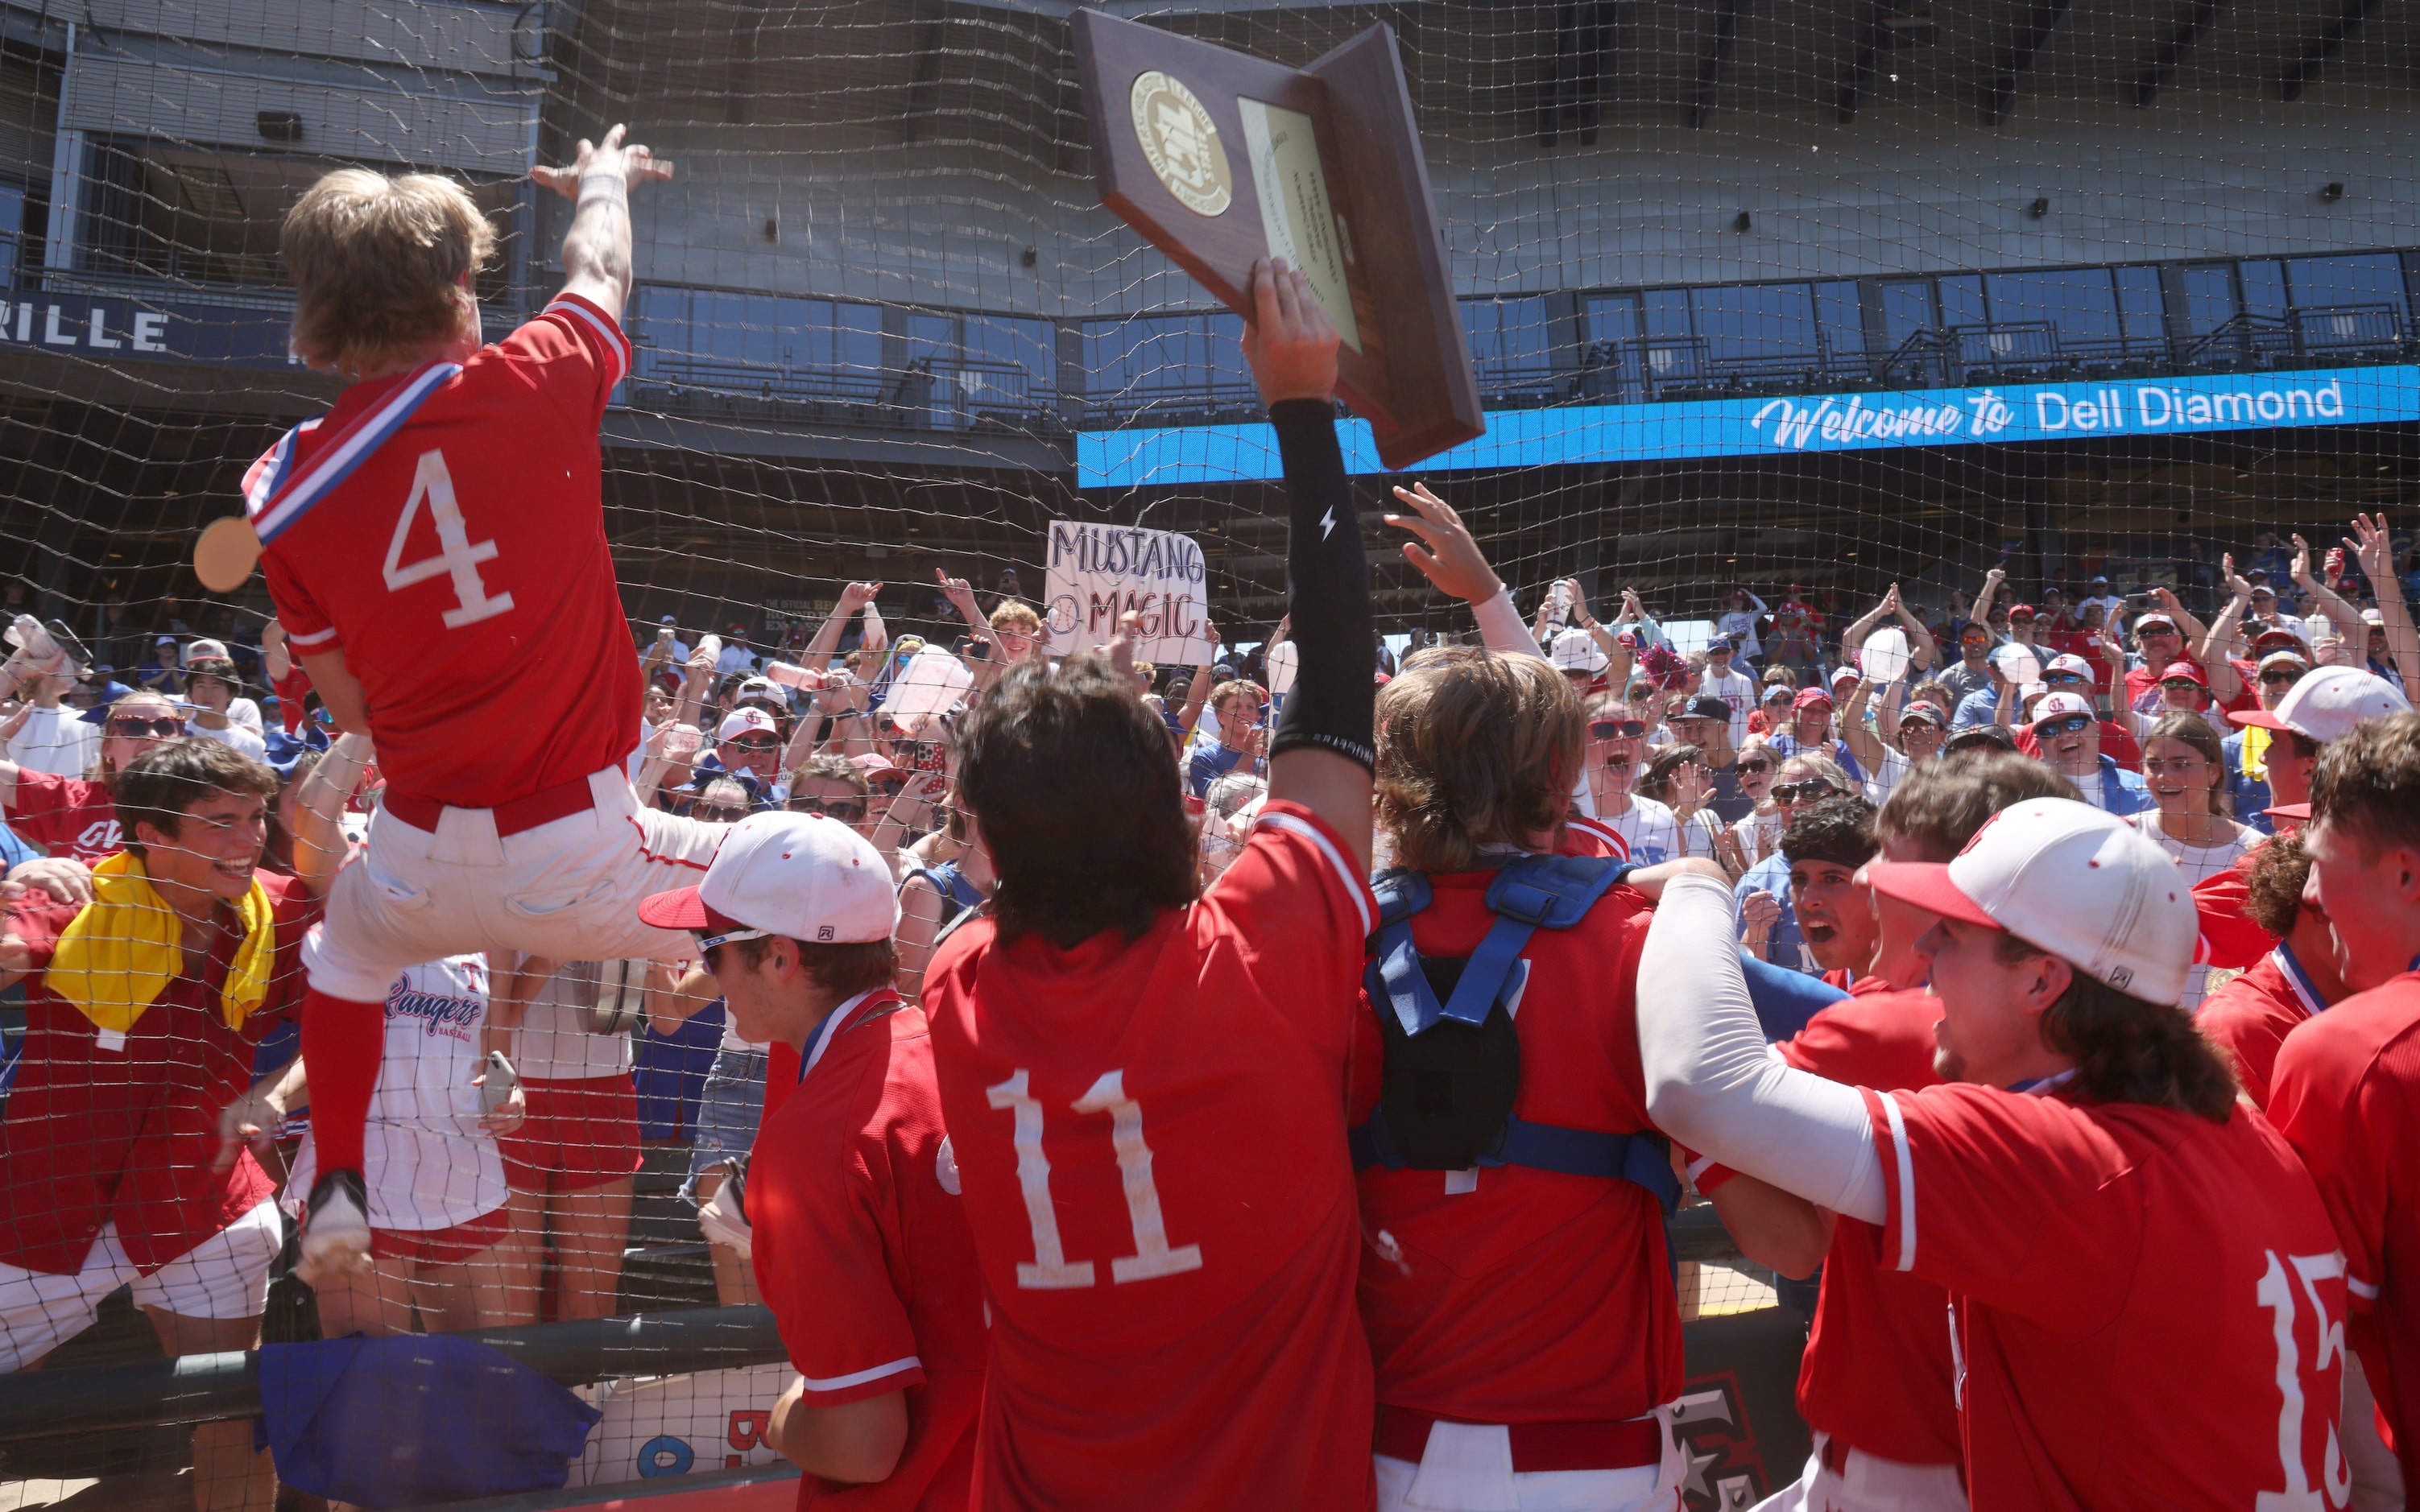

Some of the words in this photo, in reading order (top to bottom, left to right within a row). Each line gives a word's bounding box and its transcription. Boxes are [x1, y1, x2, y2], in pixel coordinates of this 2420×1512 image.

[1751, 393, 1961, 451] Welcome
[1967, 387, 2015, 435] to
[2036, 390, 2123, 432] Dell
[2140, 378, 2344, 428] Diamond
[382, 448, 514, 630] 4
[1052, 523, 1204, 584] MUSTANG
[766, 598, 779, 610] THE
[780, 599, 812, 610] OFFICIAL
[1088, 589, 1199, 640] MAGIC
[383, 970, 482, 1037] Rangers
[460, 960, 482, 994] T
[438, 1027, 471, 1043] BASEBALL
[985, 1068, 1202, 1291] 11
[2255, 1248, 2352, 1512] 15
